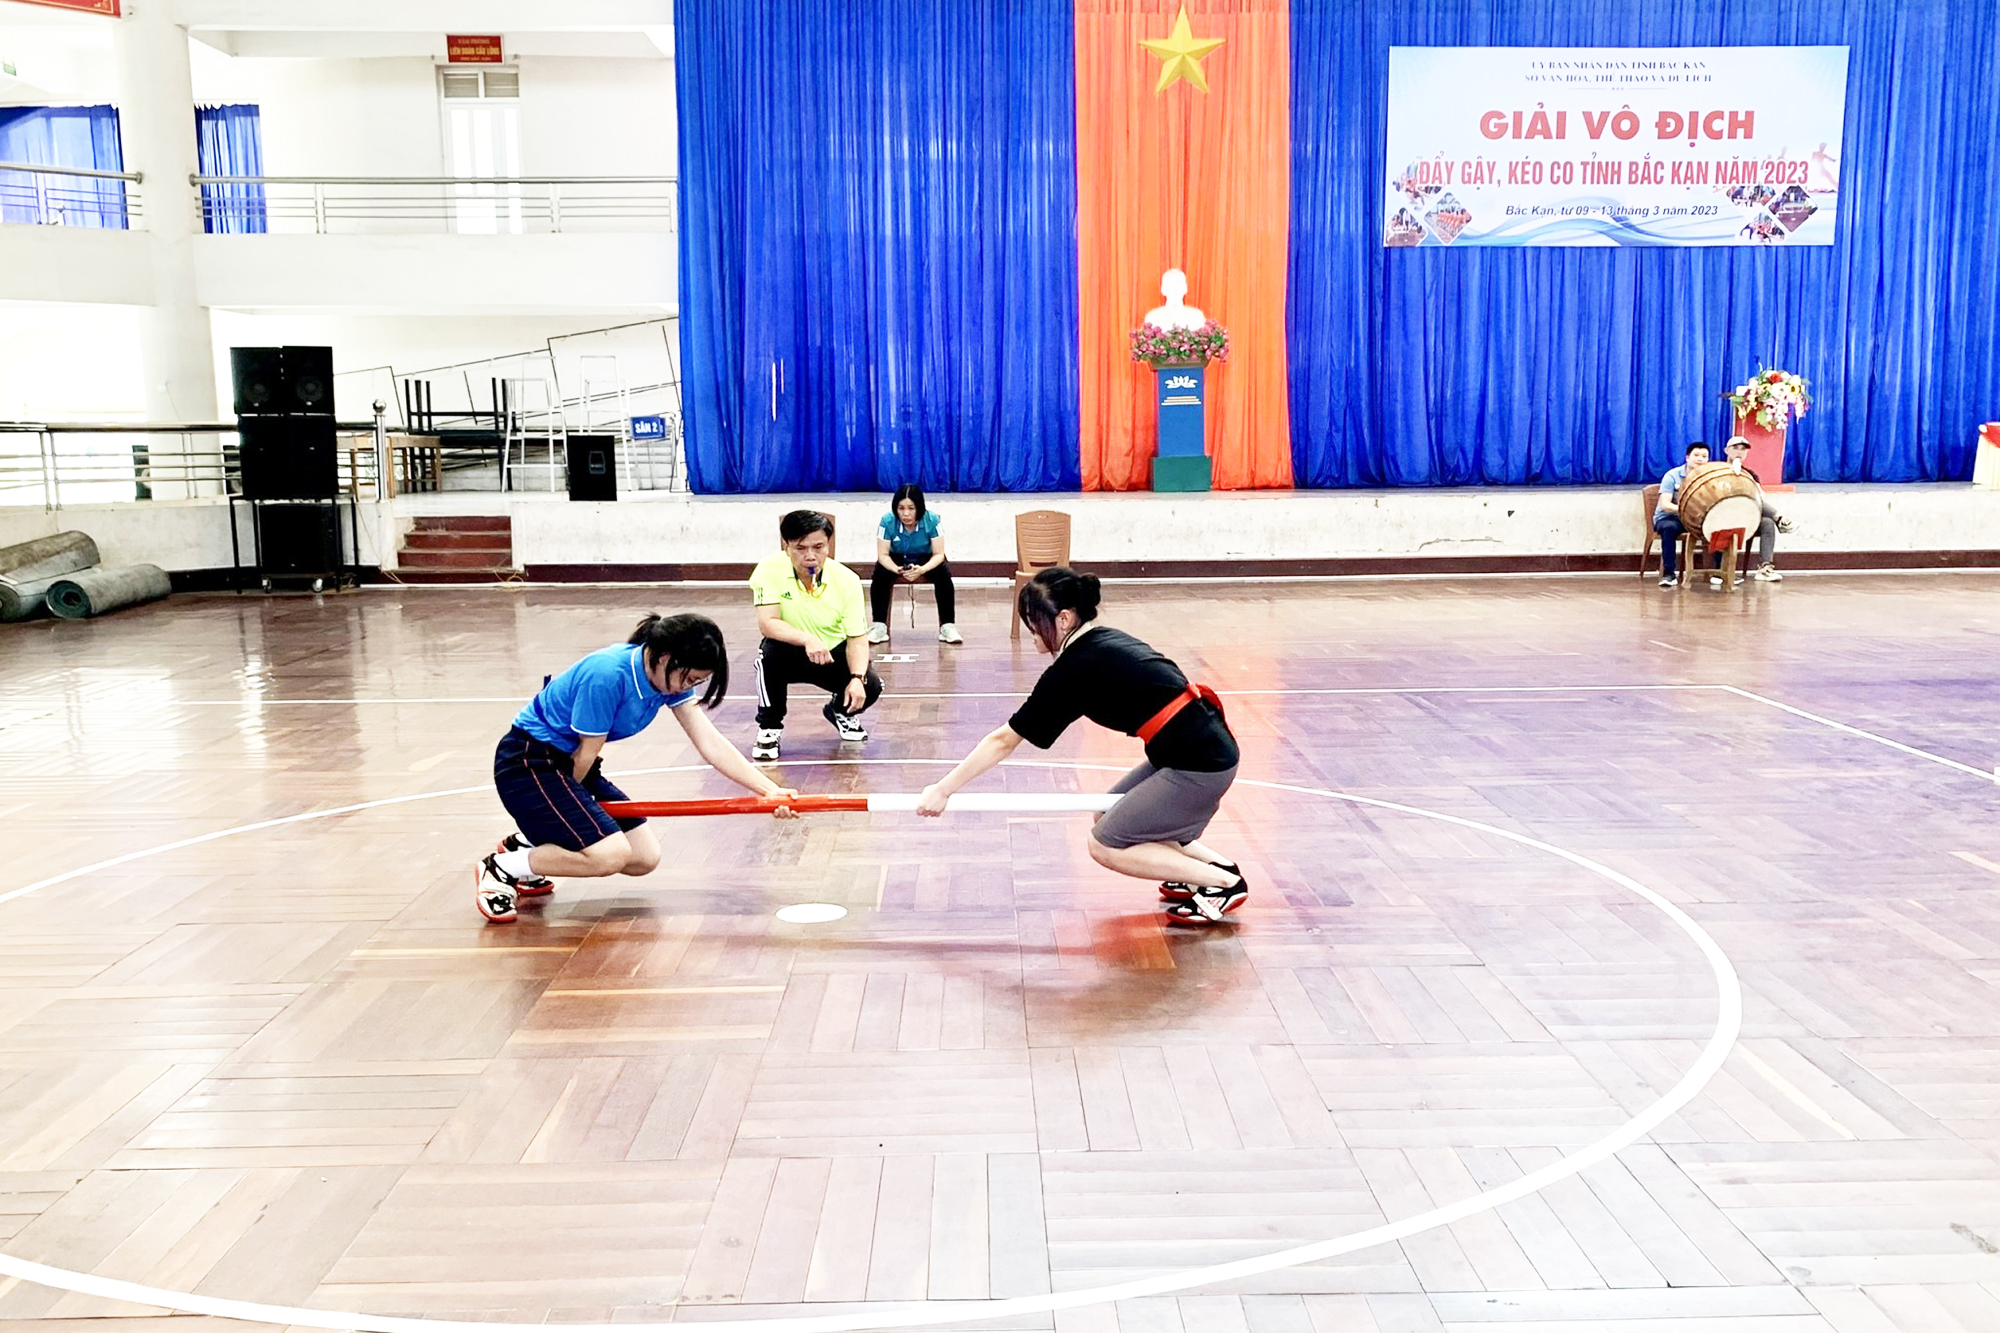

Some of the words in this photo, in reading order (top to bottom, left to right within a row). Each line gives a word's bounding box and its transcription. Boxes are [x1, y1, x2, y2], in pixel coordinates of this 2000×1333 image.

[1479, 102, 1567, 140] GIẢI
[1582, 104, 1641, 141] VÔ
[1655, 110, 1755, 148] ĐỊCH
[1418, 151, 1455, 185] ĐẨY
[1461, 155, 1501, 190] GẬY,
[1508, 156, 1544, 185] KÉO
[1550, 161, 1574, 185] CO
[1580, 151, 1622, 185] TỈNH
[1628, 152, 1665, 185] BẮC
[1671, 161, 1709, 190] KẠN
[1715, 155, 1758, 185] NĂM
[1764, 160, 1809, 185] 2023
[1575, 205, 1590, 216] 09
[1601, 205, 1613, 216] 13
[1616, 205, 1650, 218] tháng
[1652, 205, 1660, 216] 3
[1662, 205, 1688, 216] năm
[1690, 205, 1719, 216] 2023
[652, 421, 659, 433] 2
